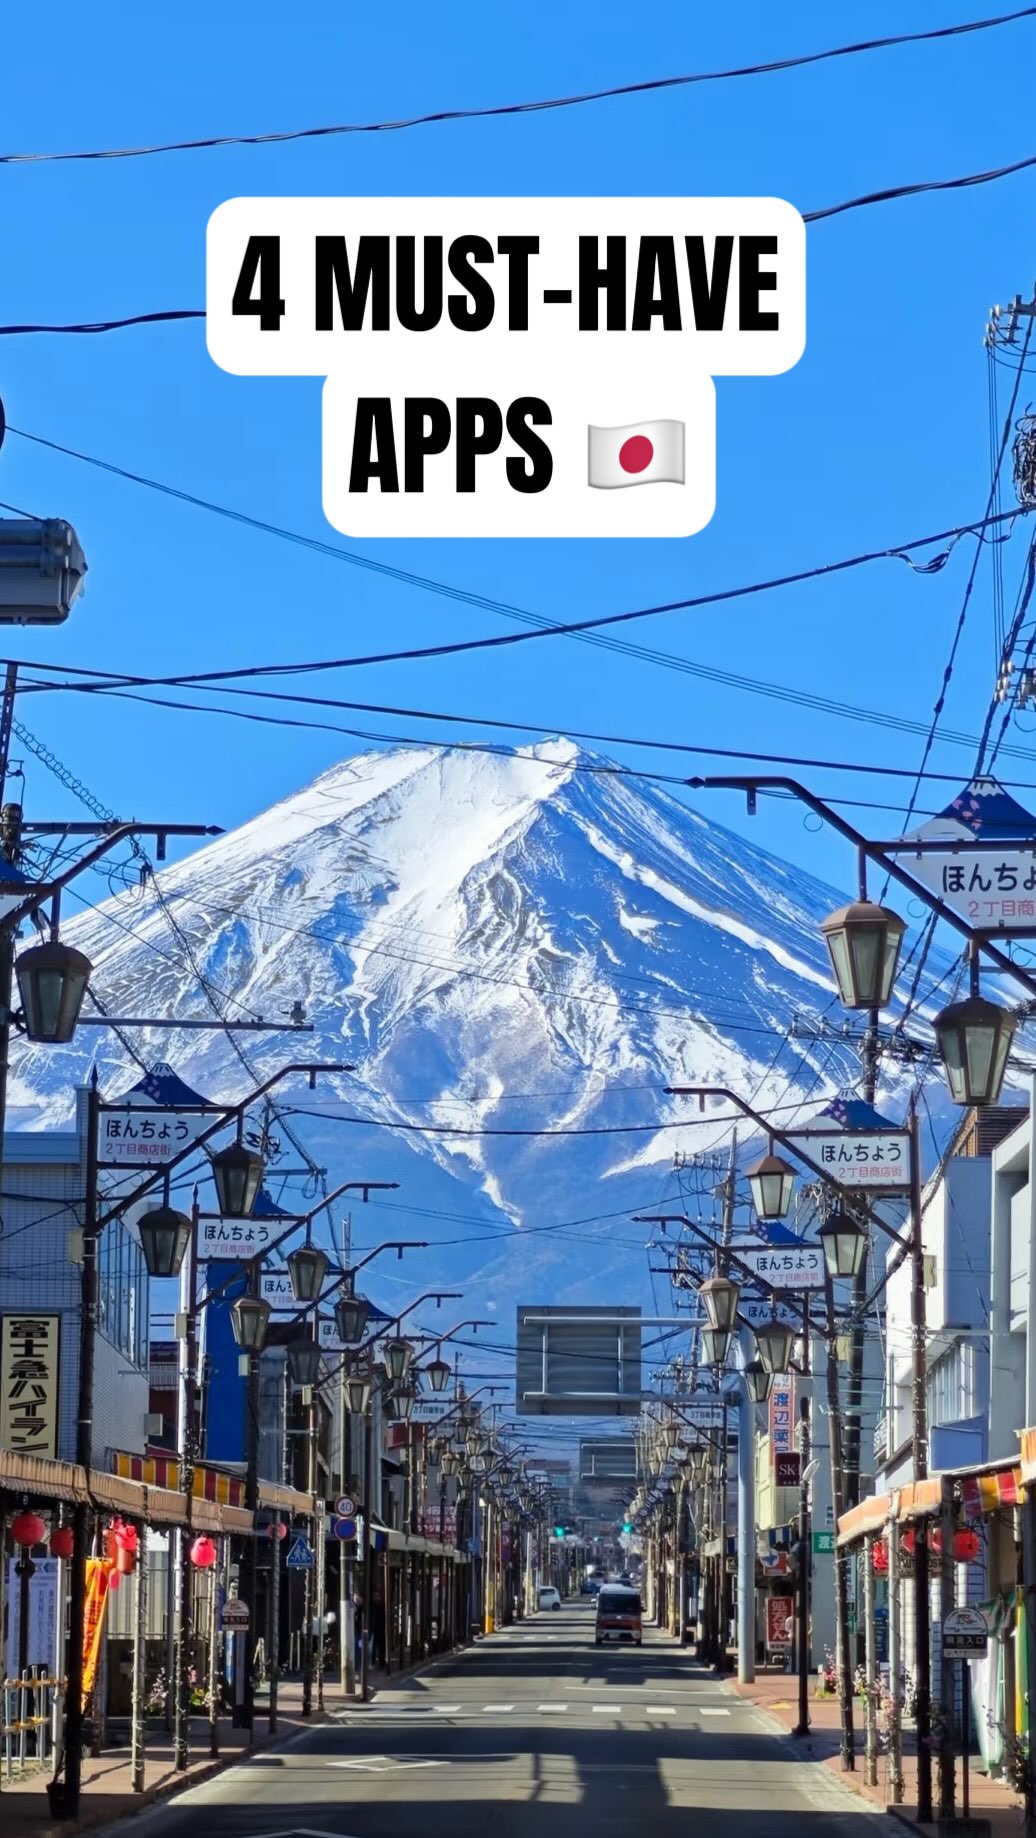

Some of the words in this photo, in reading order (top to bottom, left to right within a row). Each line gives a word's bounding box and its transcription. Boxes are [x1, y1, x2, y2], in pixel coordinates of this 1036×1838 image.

[106, 1119, 189, 1140] ほんちょう
[821, 1142, 902, 1163] ほんちょう
[204, 1225, 269, 1241] ほんちょう
[756, 1254, 819, 1271] ほんちょう
[340, 1501, 353, 1512] 40
